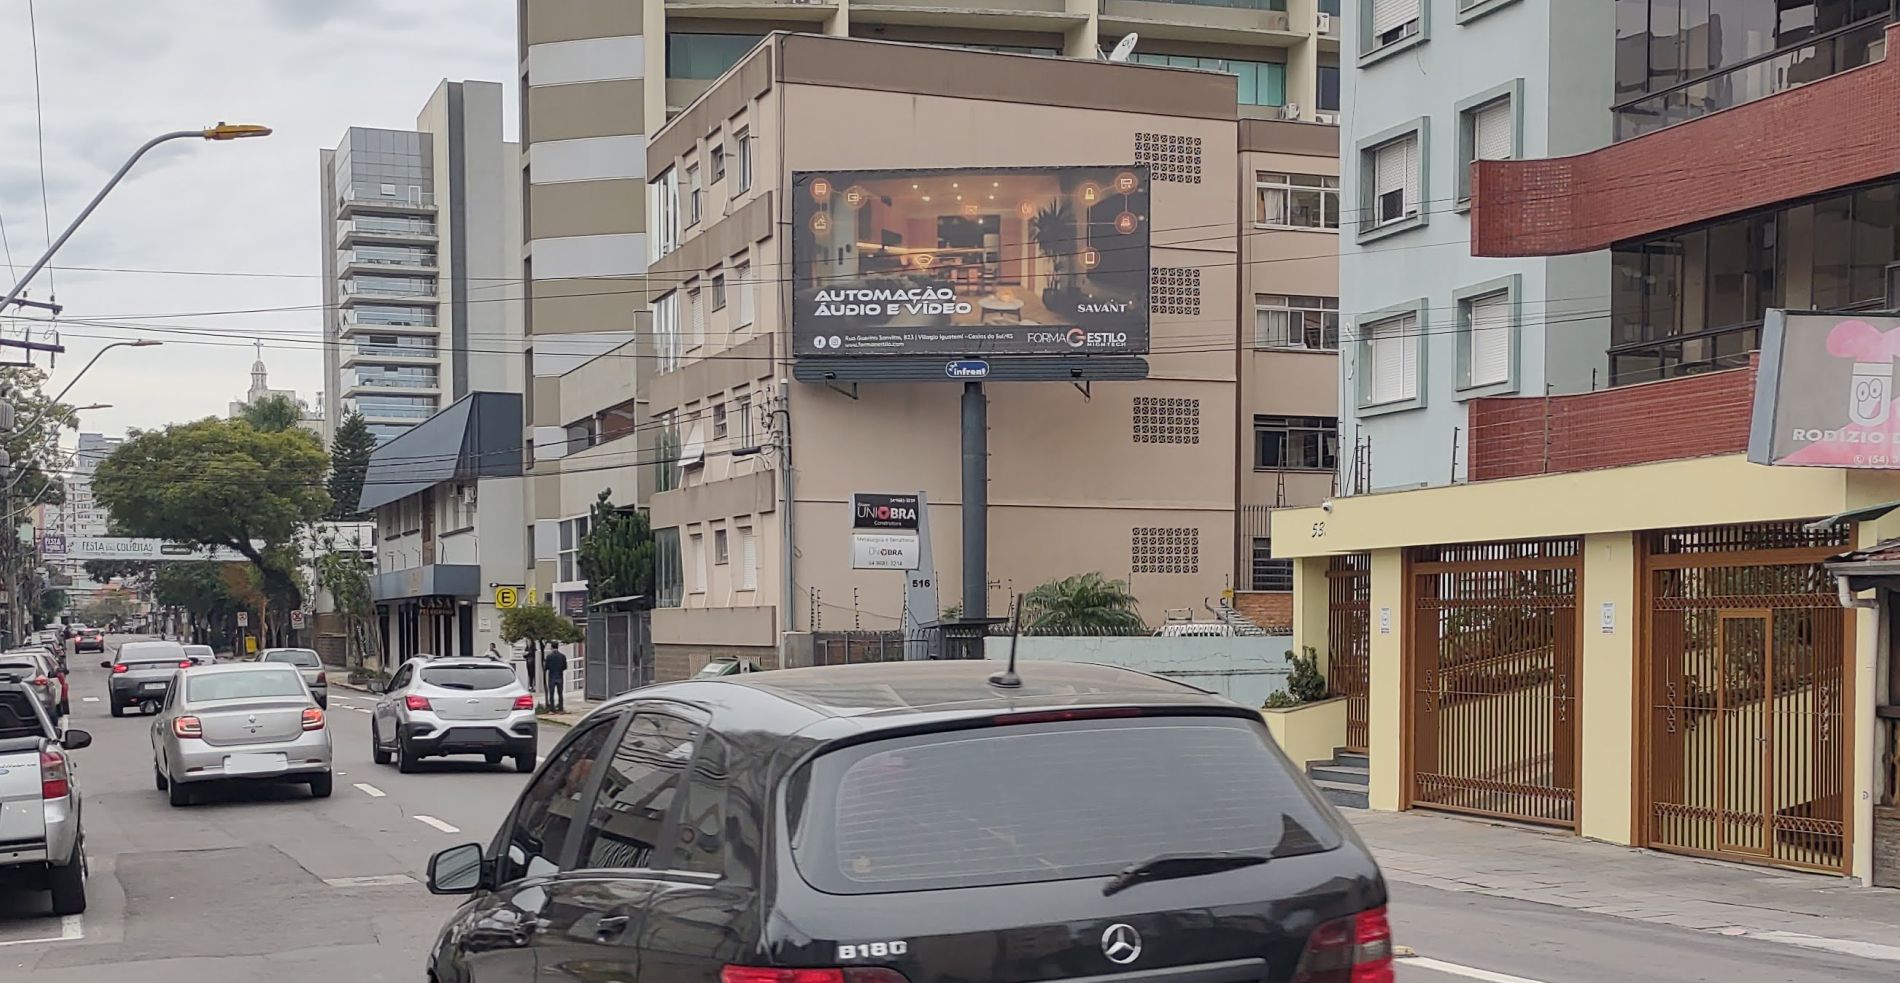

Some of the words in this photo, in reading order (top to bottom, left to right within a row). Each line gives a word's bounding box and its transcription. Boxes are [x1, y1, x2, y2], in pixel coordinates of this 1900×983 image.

[814, 286, 957, 304] AUTOMAÇÃO,
[814, 302, 881, 316] ÁUDIO
[886, 303, 900, 315] E
[905, 301, 972, 315] VÍDEO
[1077, 304, 1127, 313] SAVANT
[1027, 332, 1067, 343] FORMA
[1087, 333, 1127, 343] ESTILO
[954, 367, 985, 376] infront
[1869, 456, 1889, 465] (54)
[82, 541, 105, 551] FESTA
[912, 579, 931, 588] 516
[502, 591, 511, 604] E
[838, 940, 907, 959] B180
